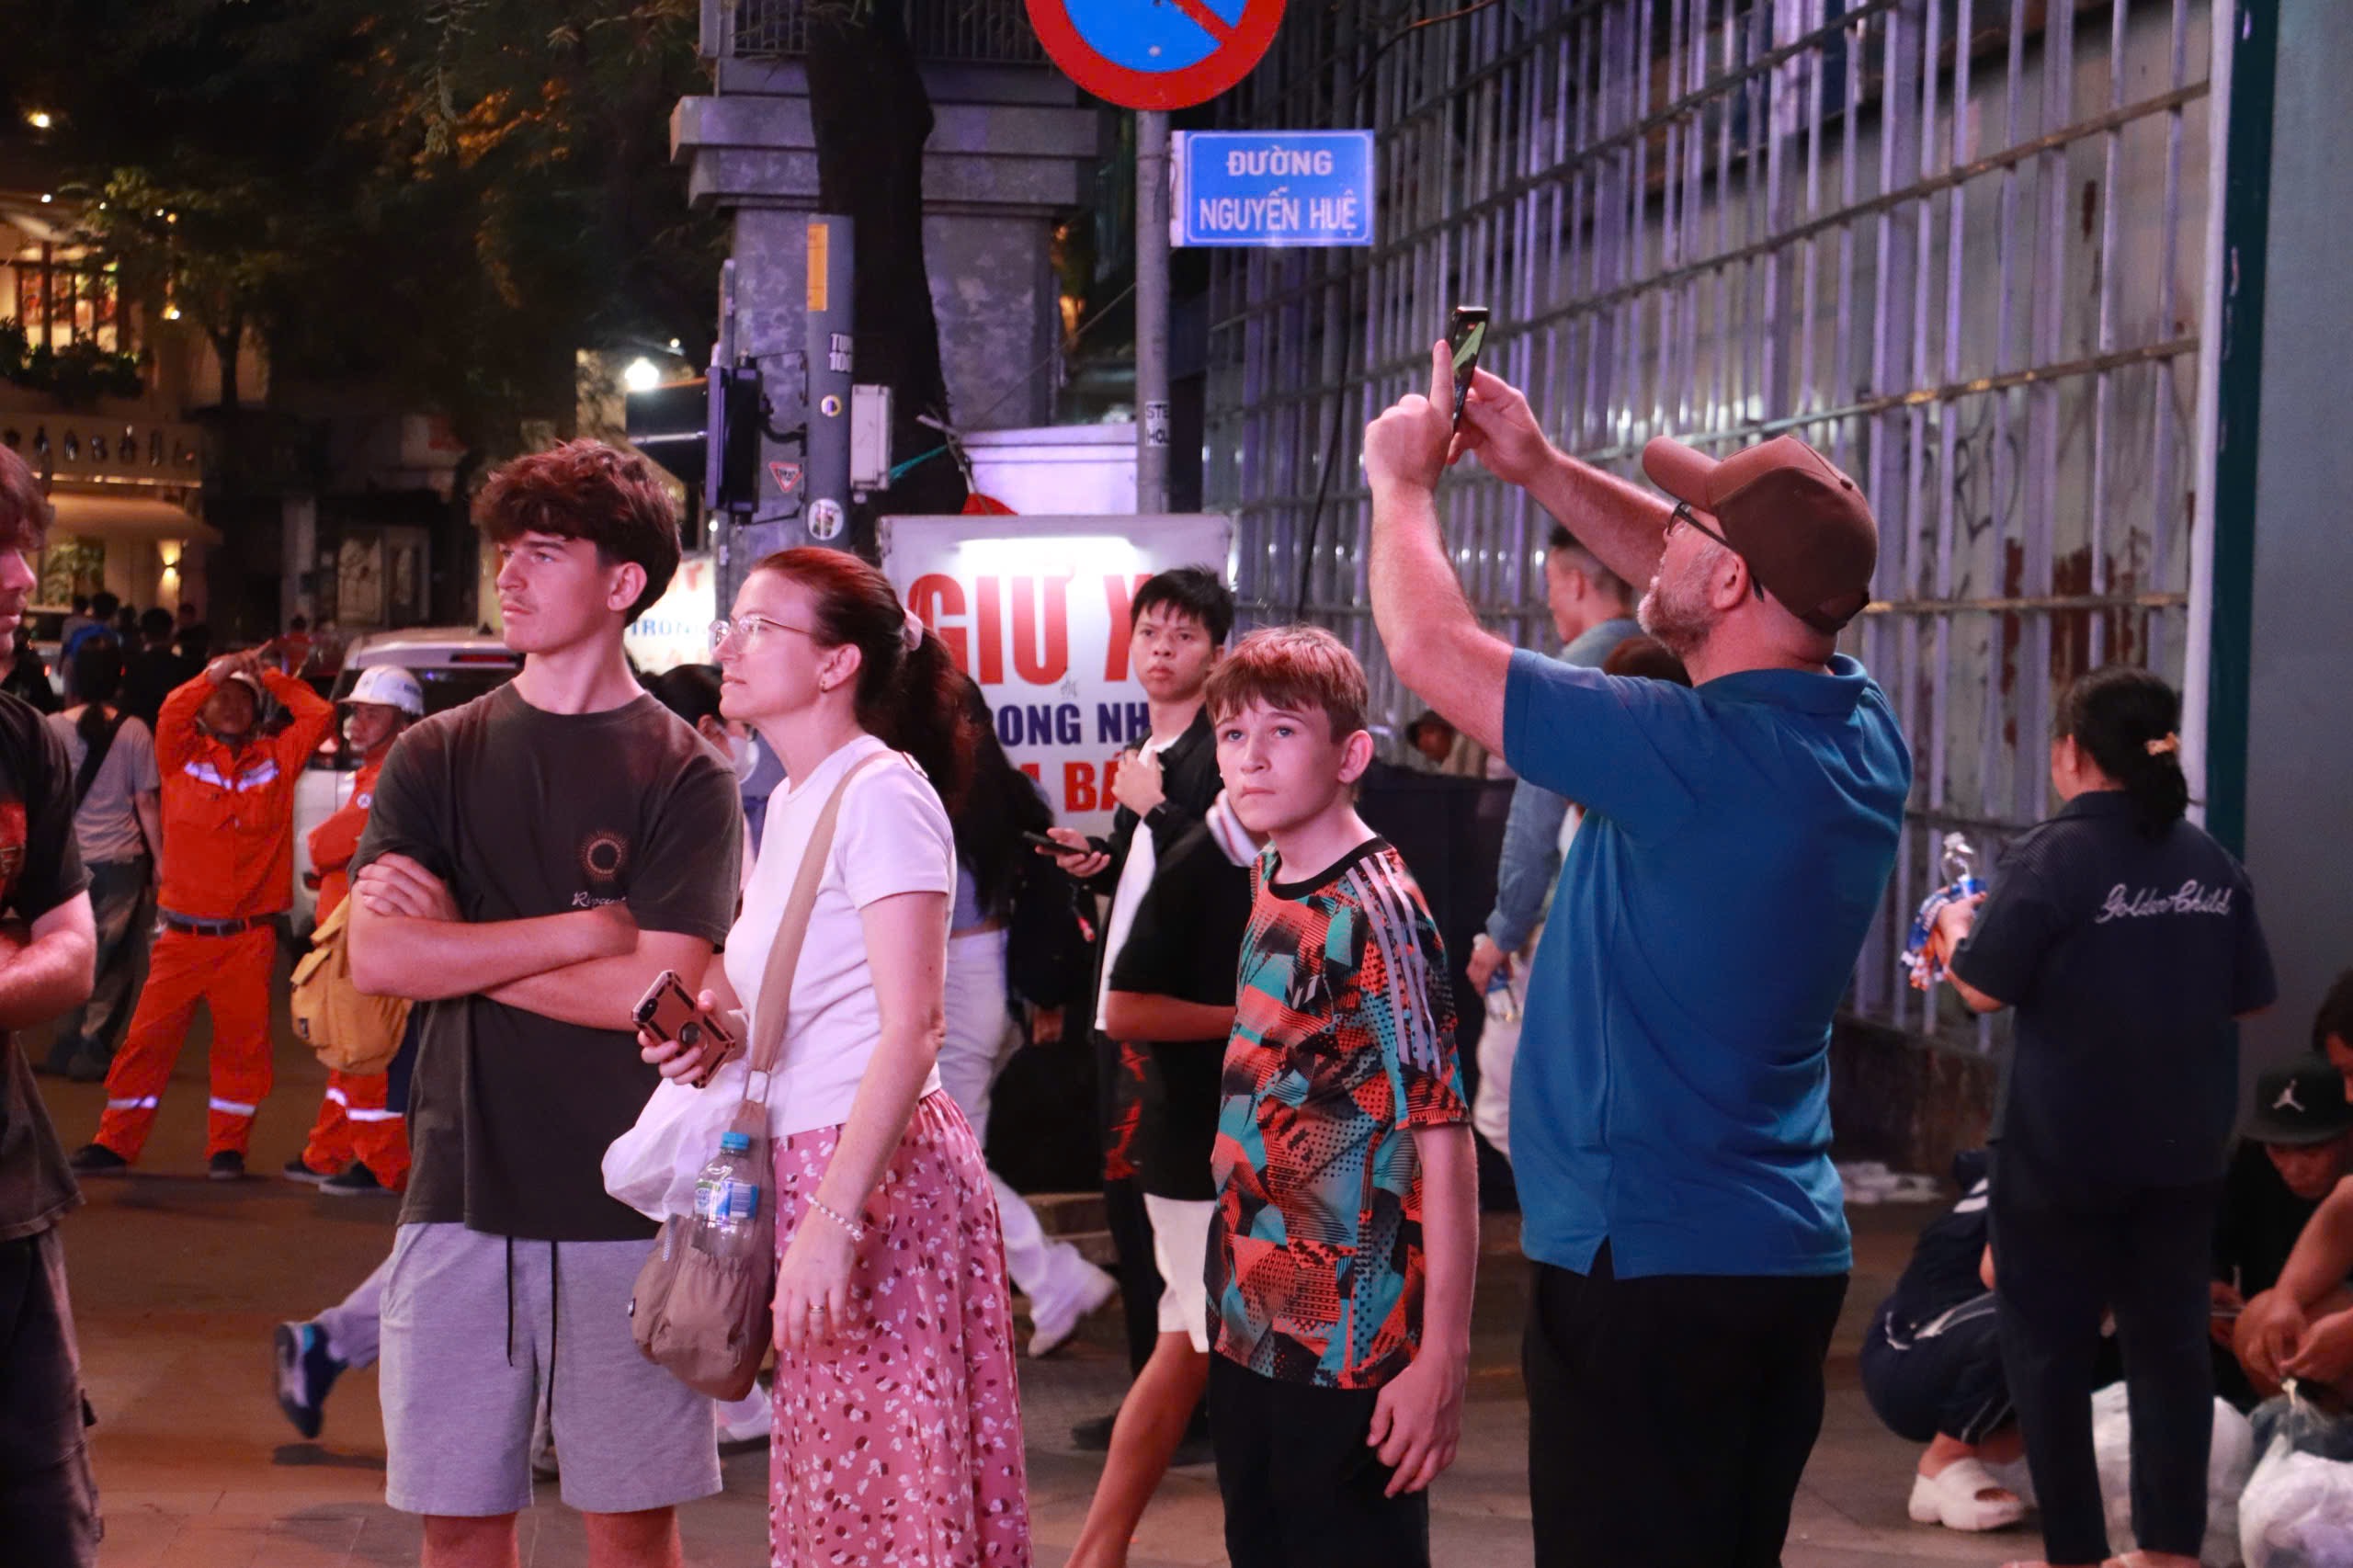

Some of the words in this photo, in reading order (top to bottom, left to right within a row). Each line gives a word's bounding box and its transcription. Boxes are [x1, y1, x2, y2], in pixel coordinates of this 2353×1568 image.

[1226, 145, 1333, 176] ĐƯỜNG
[1199, 187, 1300, 230] NGUYỄN
[1309, 189, 1358, 237] HUỆ
[998, 703, 1082, 746] ONG
[1097, 702, 1151, 744] NH
[2167, 879, 2233, 915] Child
